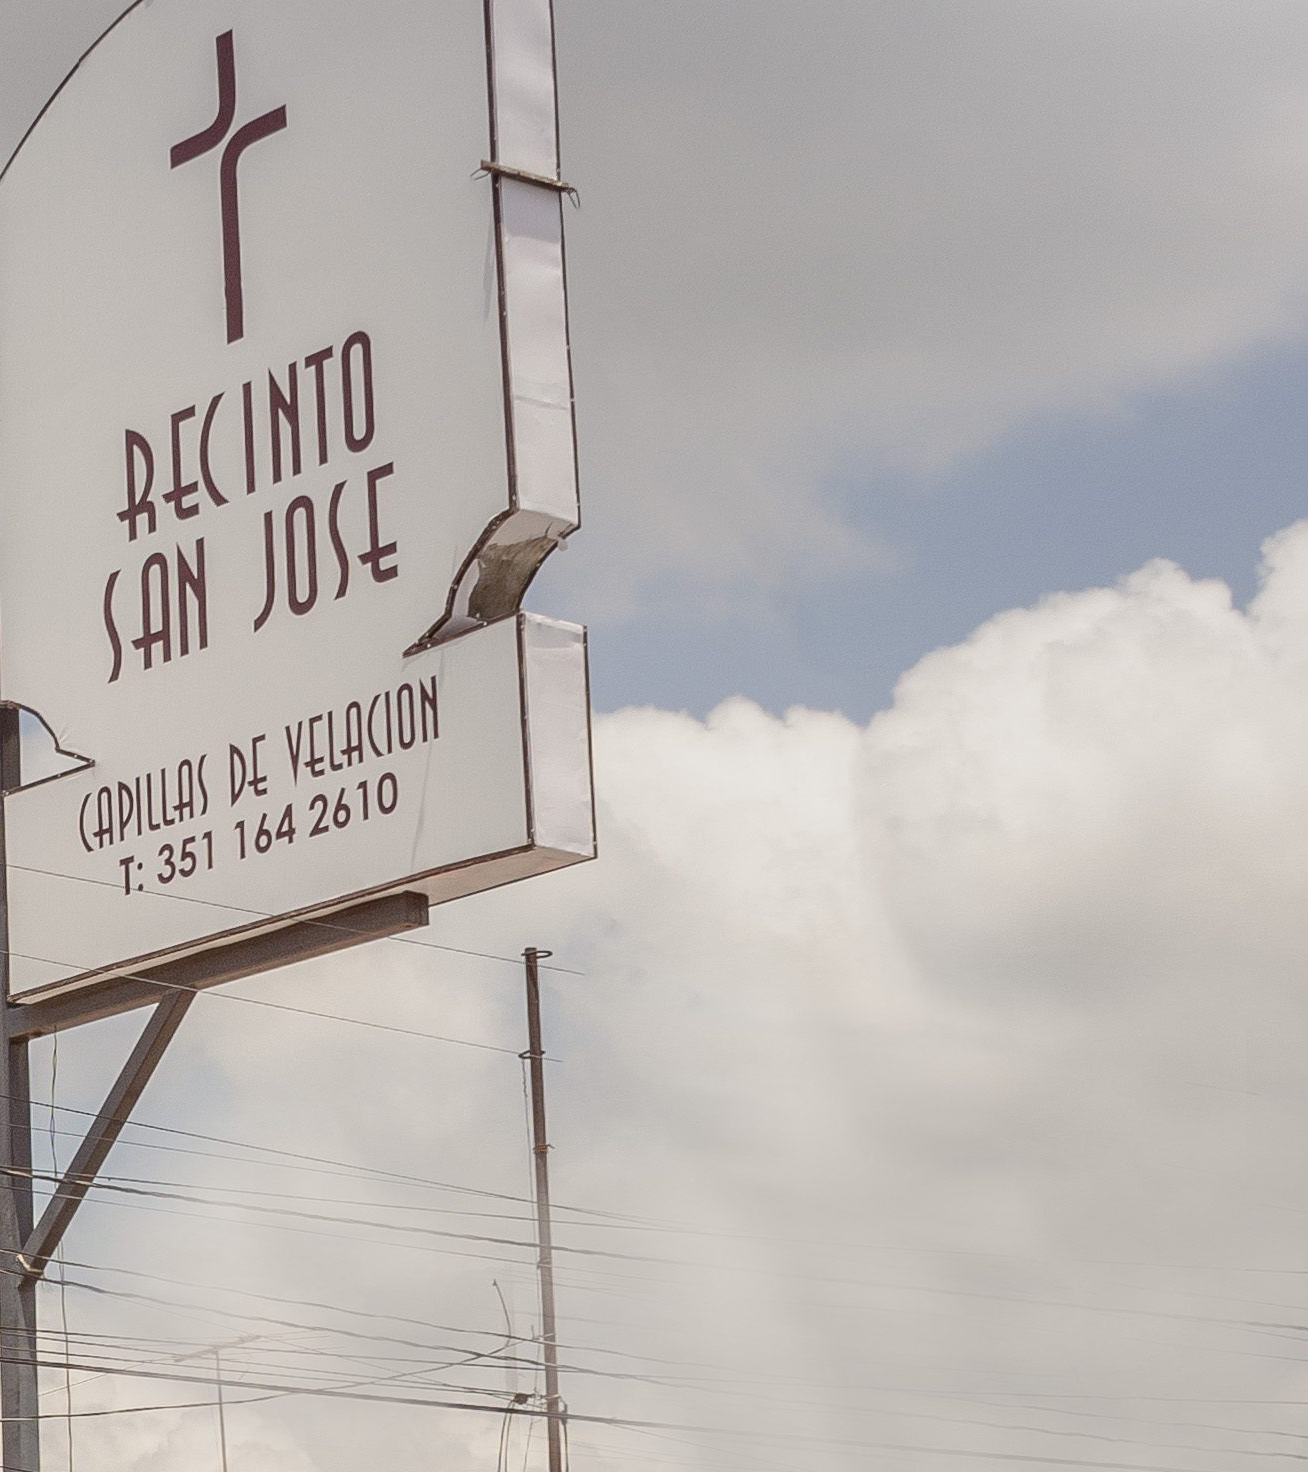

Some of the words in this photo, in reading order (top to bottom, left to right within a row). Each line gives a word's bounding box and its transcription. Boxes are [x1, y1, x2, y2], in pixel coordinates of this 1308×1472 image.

[116, 330, 376, 543] RECINTO
[103, 536, 209, 684] SAN
[253, 461, 399, 634] JOSE
[78, 752, 209, 853] CAPILLAS
[228, 733, 269, 808] DE
[284, 674, 440, 788] VELACION
[118, 855, 145, 896] T:
[156, 830, 215, 885] 351
[233, 802, 297, 861] 164
[307, 771, 399, 838] 2610
